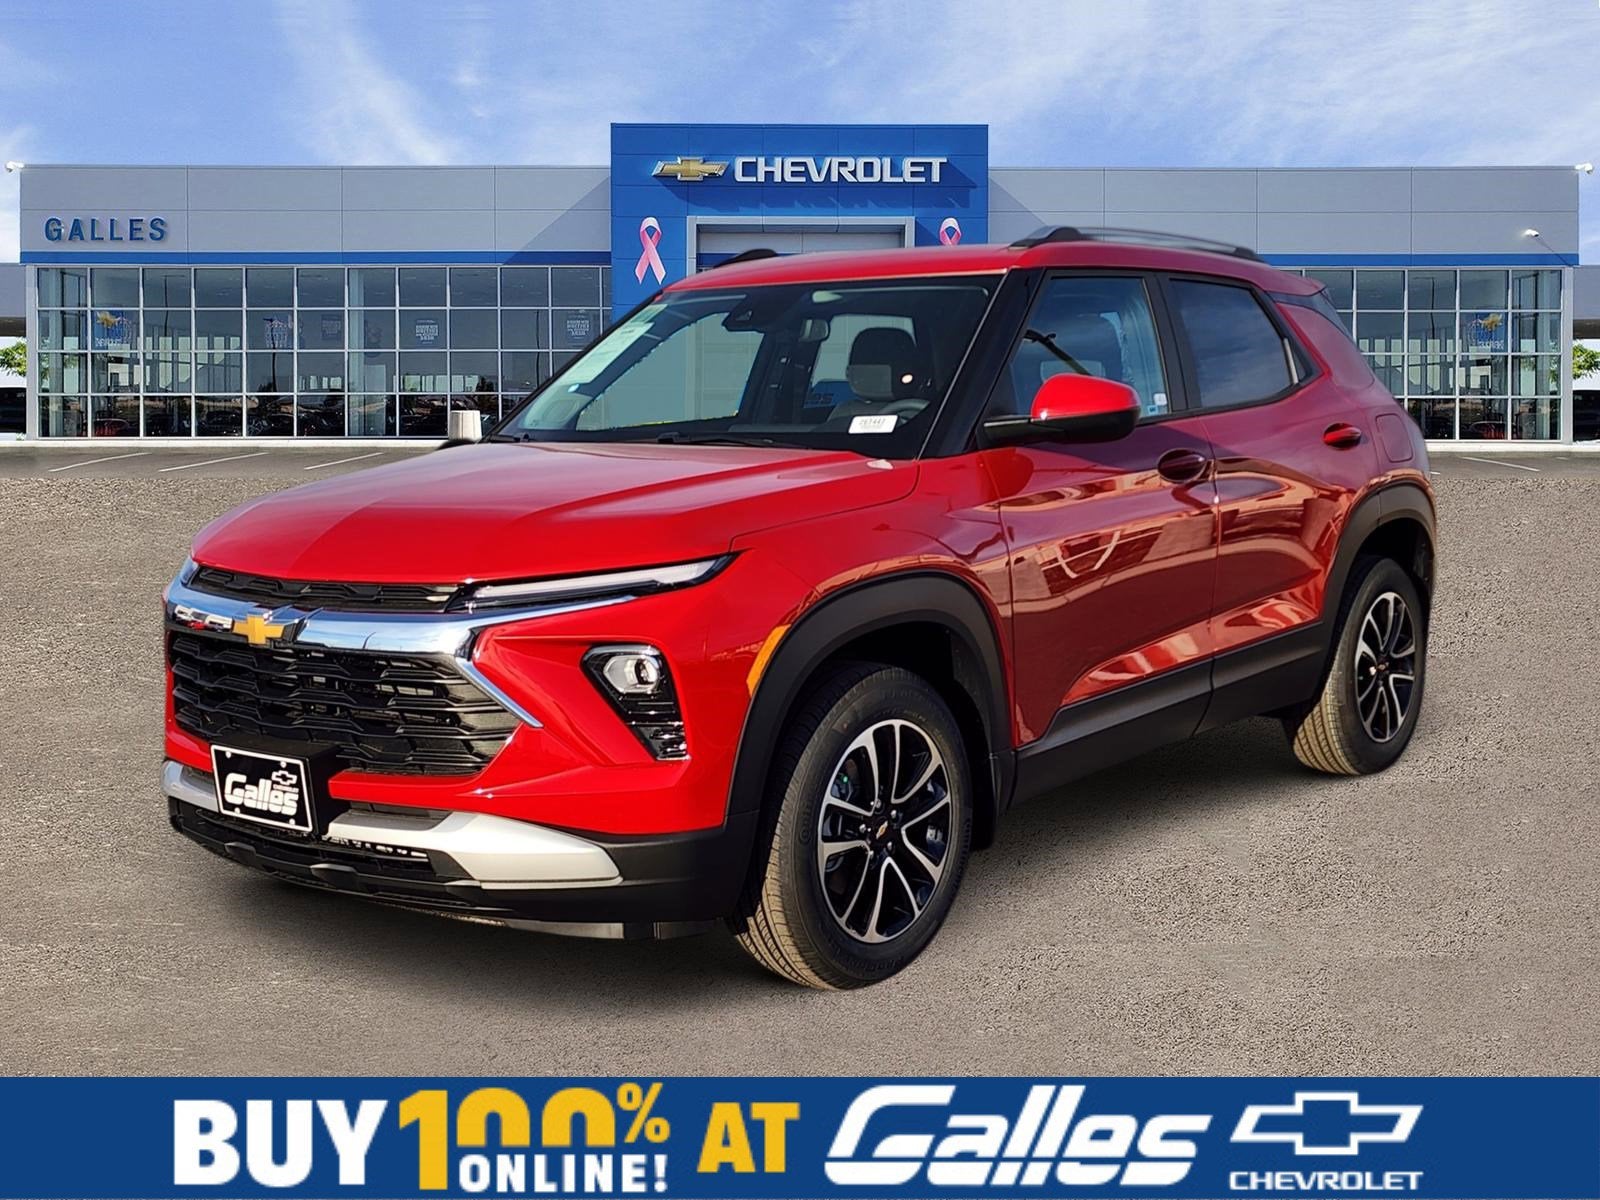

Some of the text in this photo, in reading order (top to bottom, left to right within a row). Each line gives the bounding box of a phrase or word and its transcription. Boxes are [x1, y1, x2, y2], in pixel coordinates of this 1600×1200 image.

[734, 156, 948, 183] CHEVROLET
[44, 217, 167, 241] GALLES
[224, 772, 299, 816] Galles
